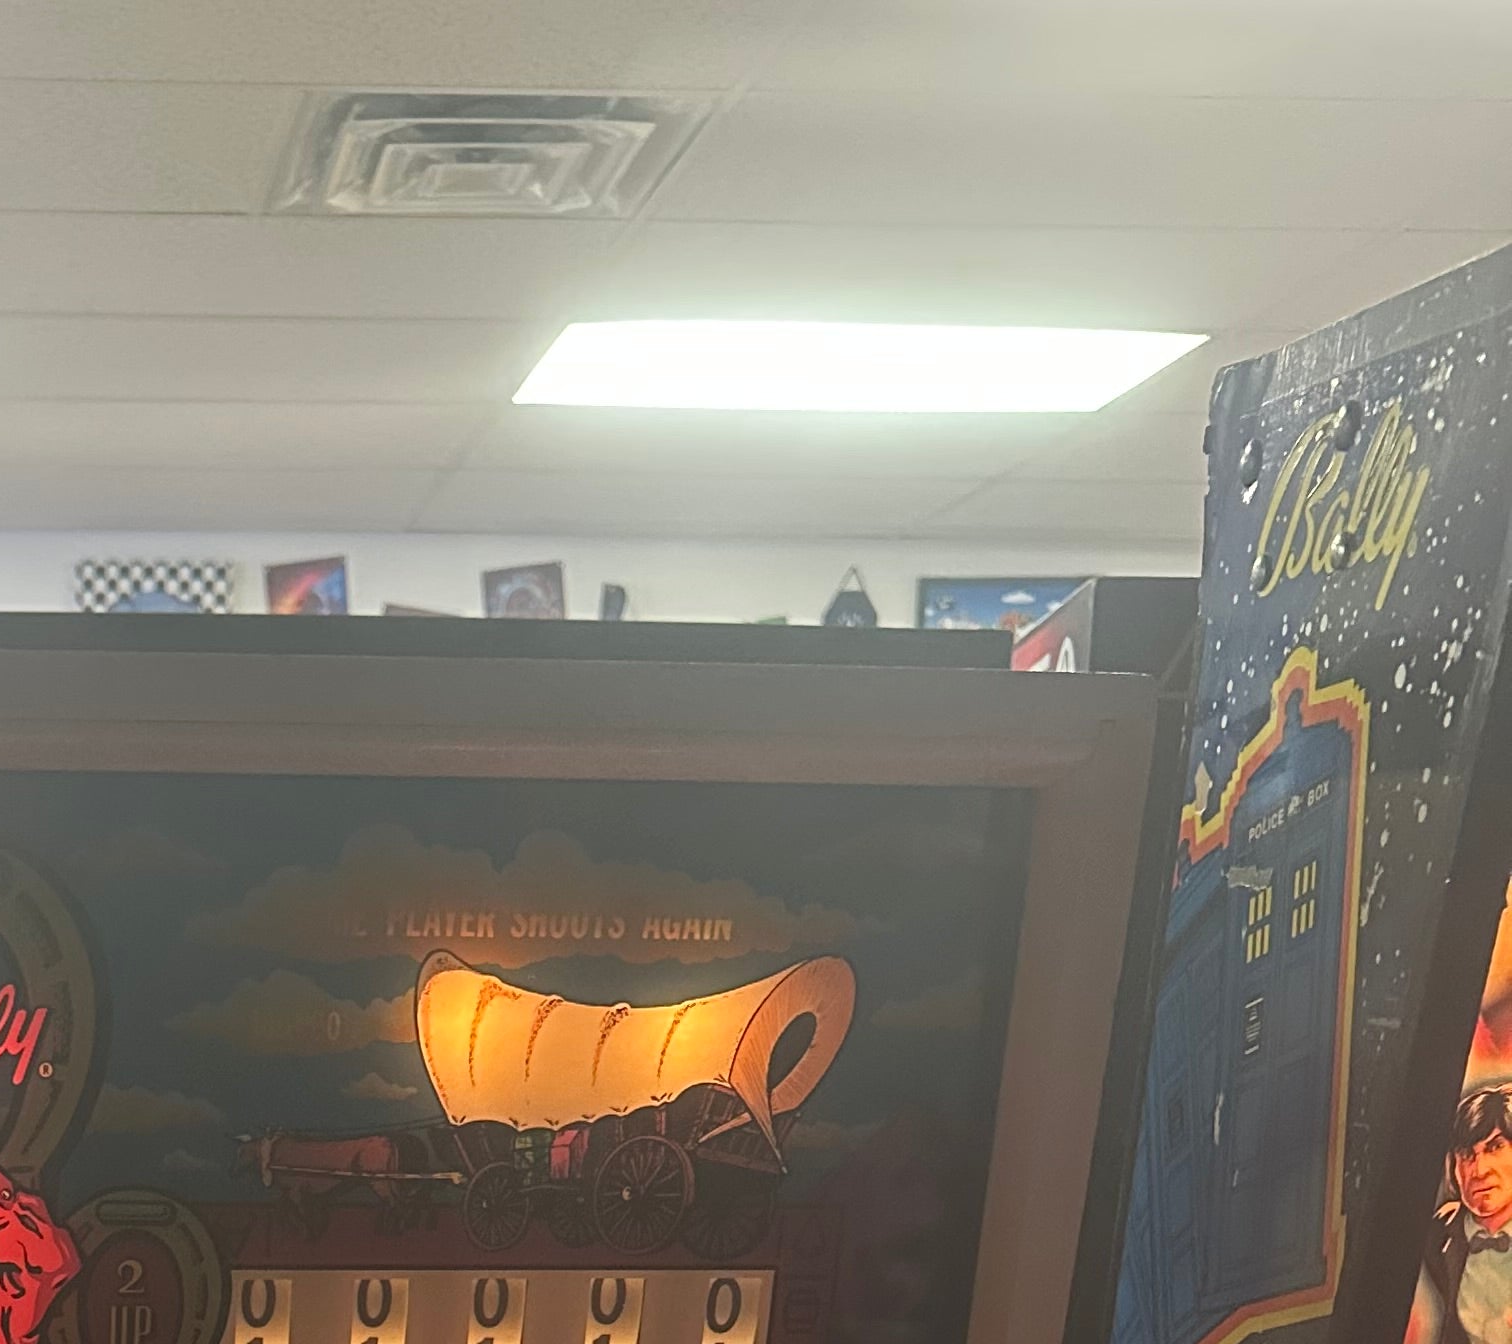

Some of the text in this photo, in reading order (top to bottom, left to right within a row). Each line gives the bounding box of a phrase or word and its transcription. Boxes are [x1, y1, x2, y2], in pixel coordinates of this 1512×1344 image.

[1255, 398, 1431, 612] Bally
[1248, 808, 1285, 844] POLICE
[1307, 780, 1331, 807] BOX
[117, 1259, 145, 1296] 2
